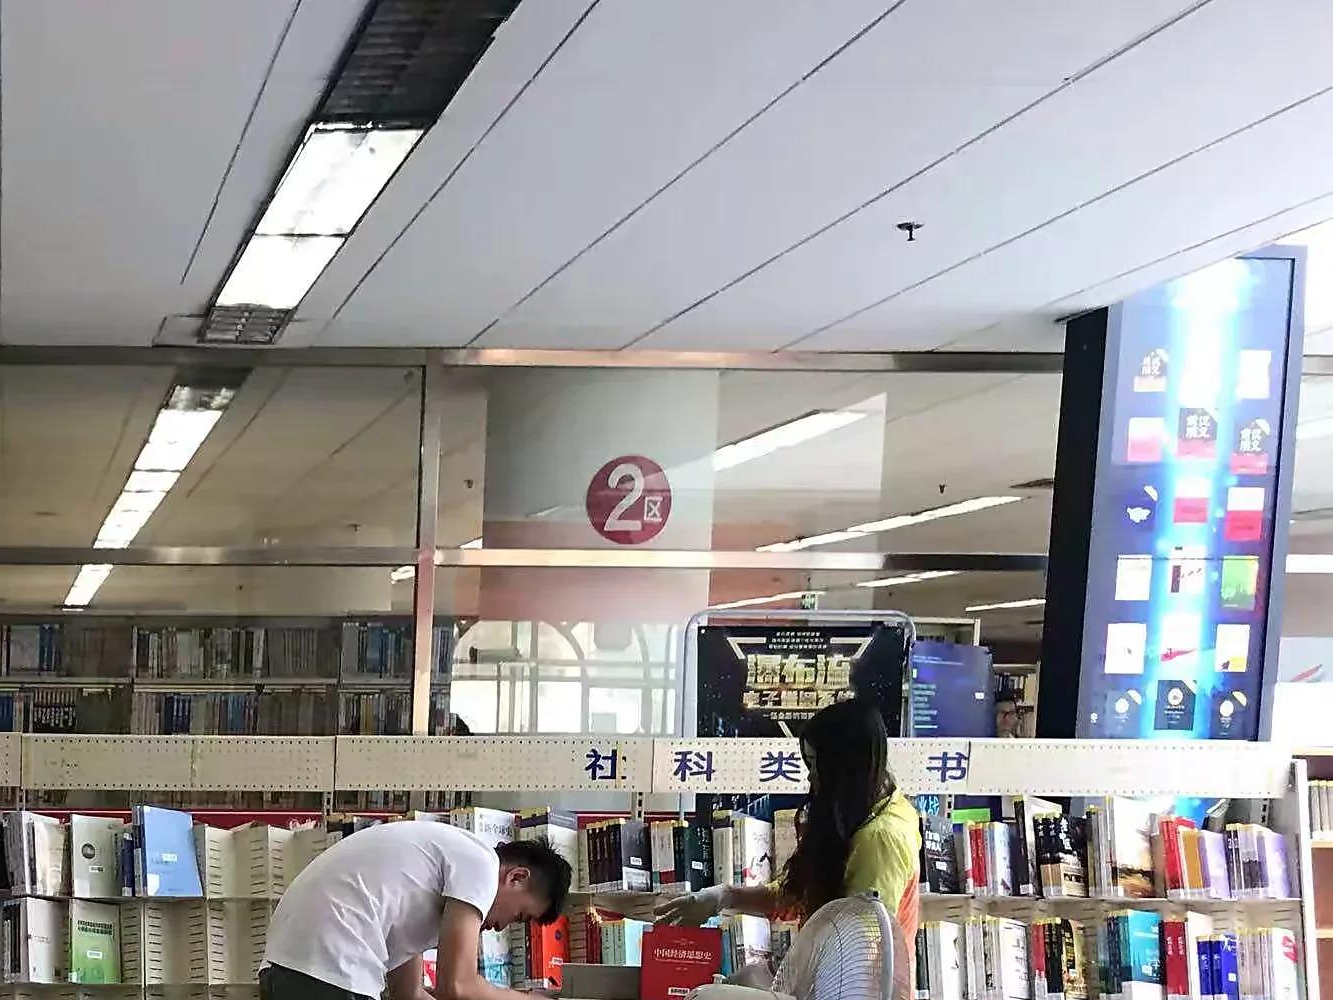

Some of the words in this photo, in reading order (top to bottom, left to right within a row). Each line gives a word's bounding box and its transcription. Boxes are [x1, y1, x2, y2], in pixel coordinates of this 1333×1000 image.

[604, 463, 664, 532] 2区
[585, 748, 970, 784] 社科类书
[654, 947, 714, 960] 中国经济思想史
